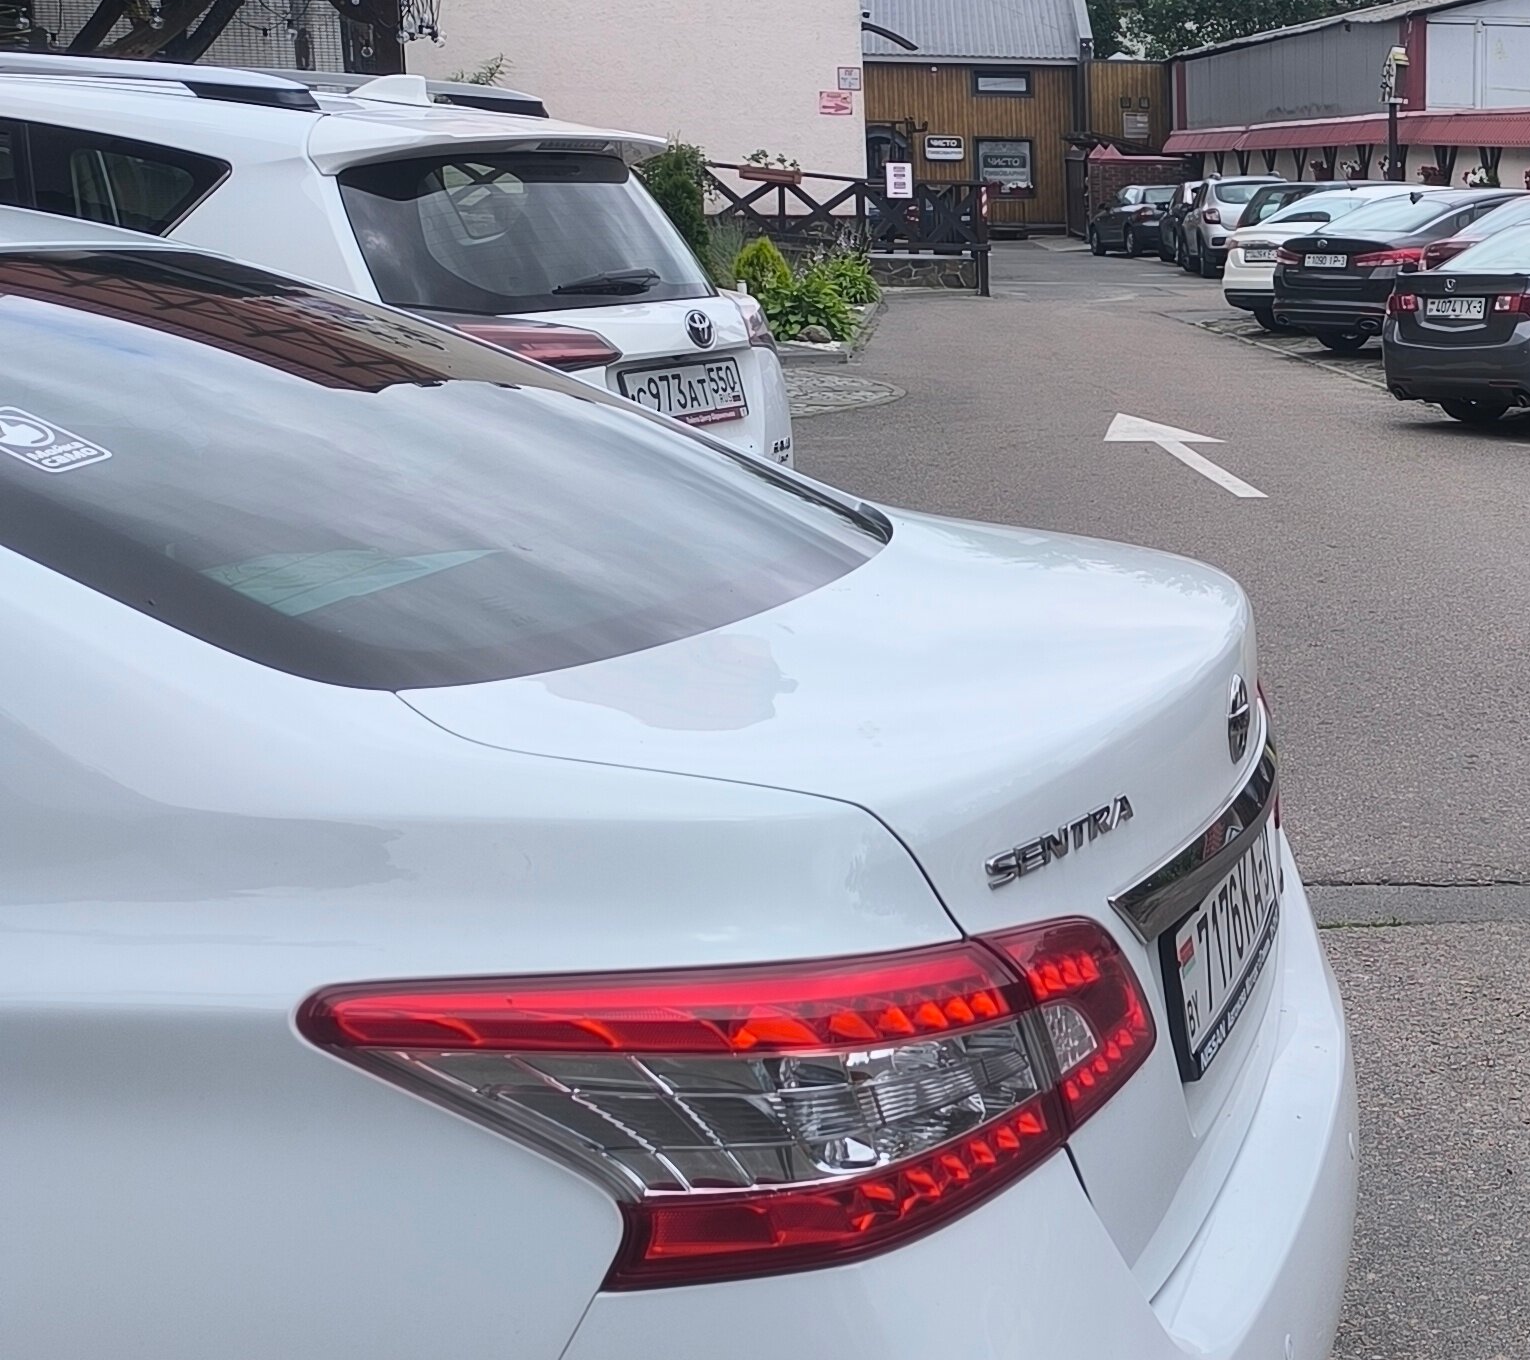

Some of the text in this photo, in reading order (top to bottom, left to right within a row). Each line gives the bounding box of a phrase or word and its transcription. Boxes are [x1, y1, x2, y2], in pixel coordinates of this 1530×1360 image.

[988, 157, 1020, 166] ЧИСТО
[707, 365, 738, 394] 550
[719, 393, 733, 403] RUS
[985, 793, 1134, 890] SENTRA
[1187, 989, 1201, 1038] BY
